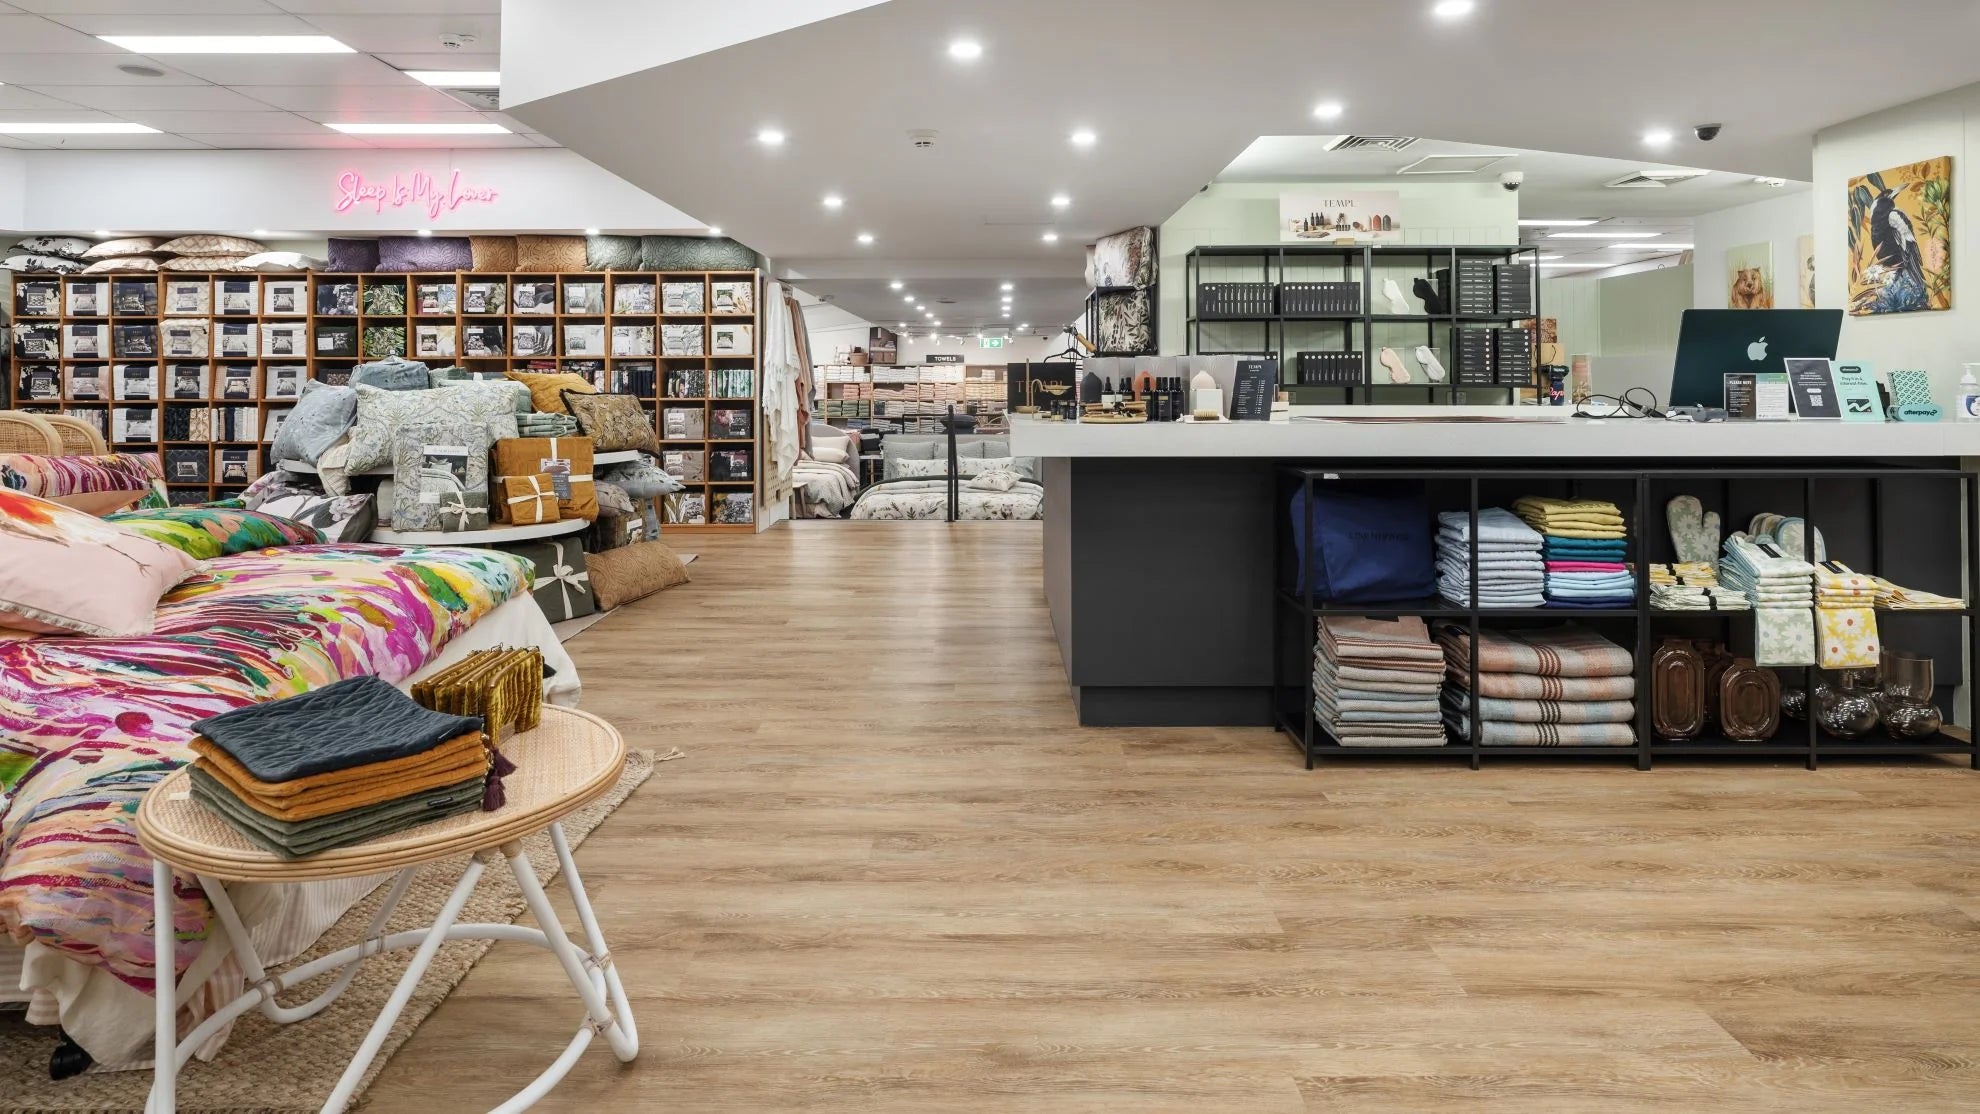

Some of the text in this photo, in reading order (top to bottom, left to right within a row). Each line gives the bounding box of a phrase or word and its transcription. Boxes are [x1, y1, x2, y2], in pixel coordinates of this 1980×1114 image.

[335, 169, 498, 219] Sleep Is My Lover
